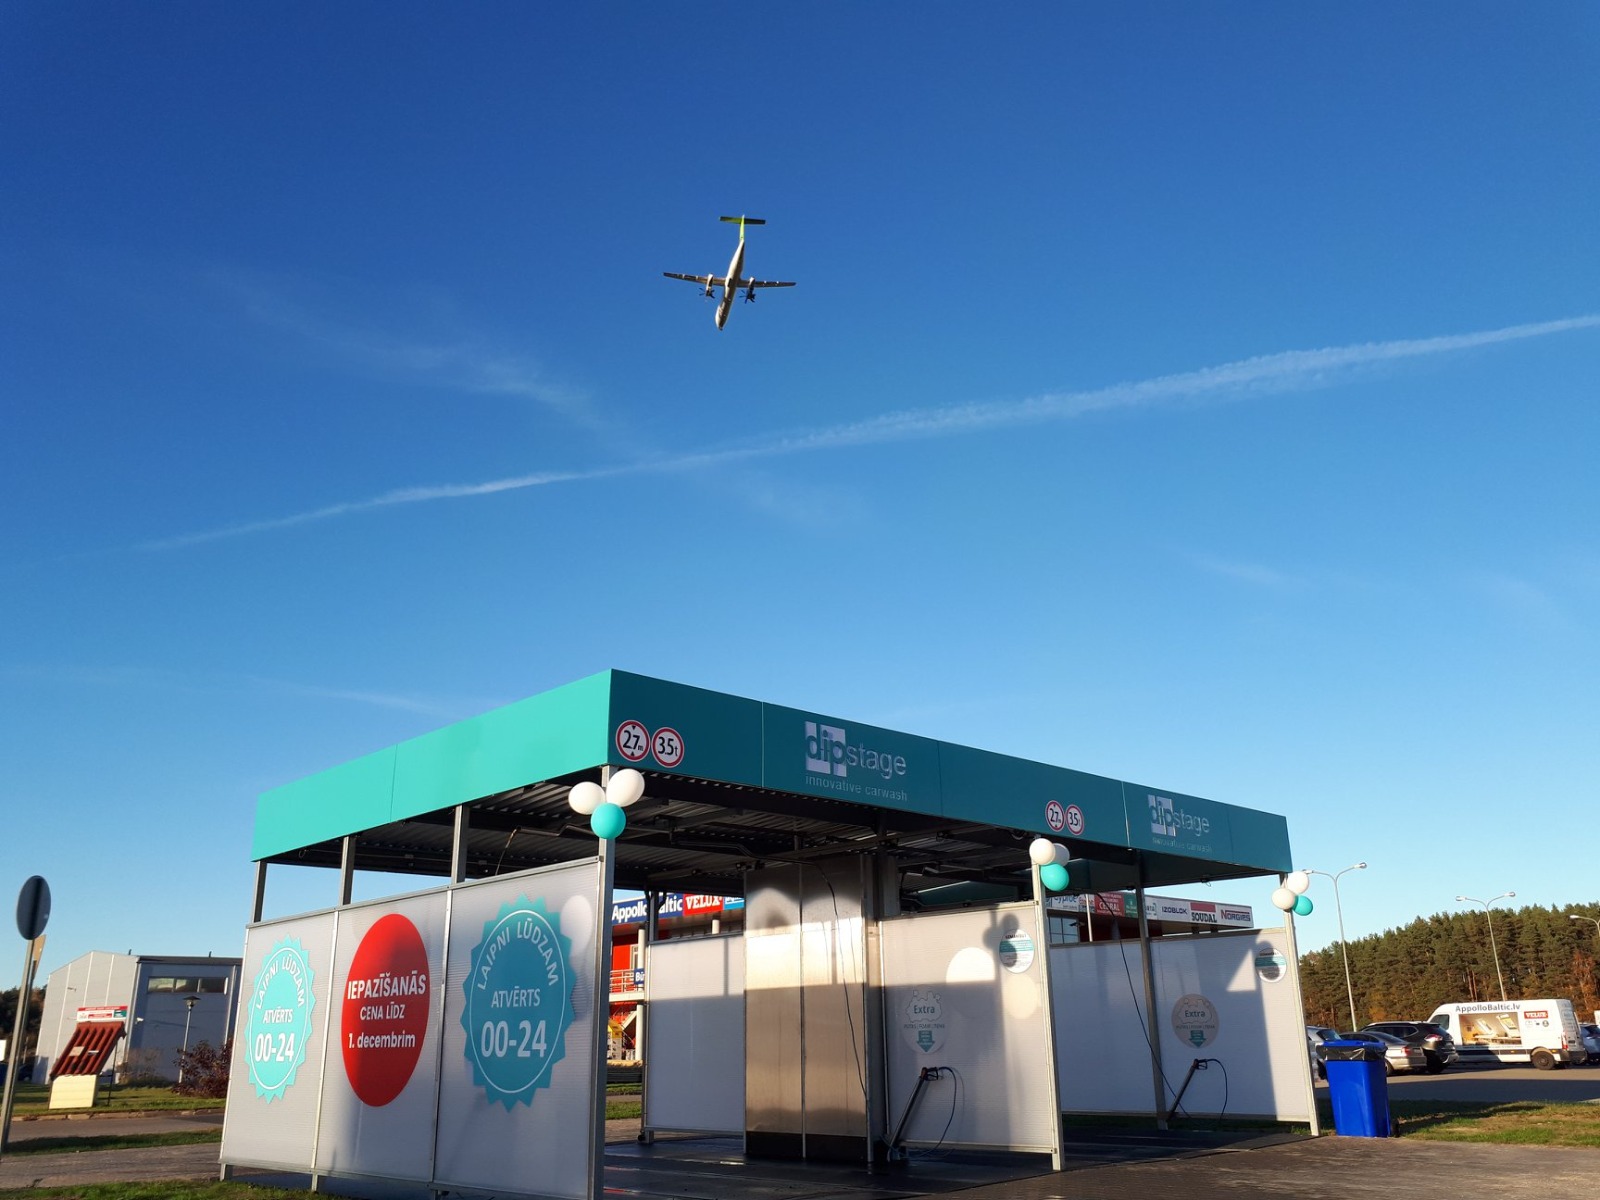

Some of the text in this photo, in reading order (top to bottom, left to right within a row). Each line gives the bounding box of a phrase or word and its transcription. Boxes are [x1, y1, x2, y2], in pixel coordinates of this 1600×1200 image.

[805, 775, 908, 802] innovative carwash
[1161, 905, 1188, 915] IZOBLOK
[1191, 911, 1218, 924] SOUDAL
[476, 917, 559, 991] LAIPNI LŪDZAM
[255, 953, 305, 1010] LAIPNI LŪDZAM
[347, 970, 427, 1000] IEPAZĪŠANĀS
[490, 985, 541, 1008] ATVĒRTS
[262, 1006, 294, 1024] ATVĒRTS
[360, 1001, 406, 1021] CENA LĪDZ
[913, 1004, 936, 1014] Extra
[1184, 1009, 1206, 1018] Extra
[1455, 1003, 1521, 1014] AppolloBaltic.lv
[254, 1032, 295, 1062] 00-24
[348, 1029, 416, 1049] 1. decembrim
[480, 1019, 547, 1058] 00-24
